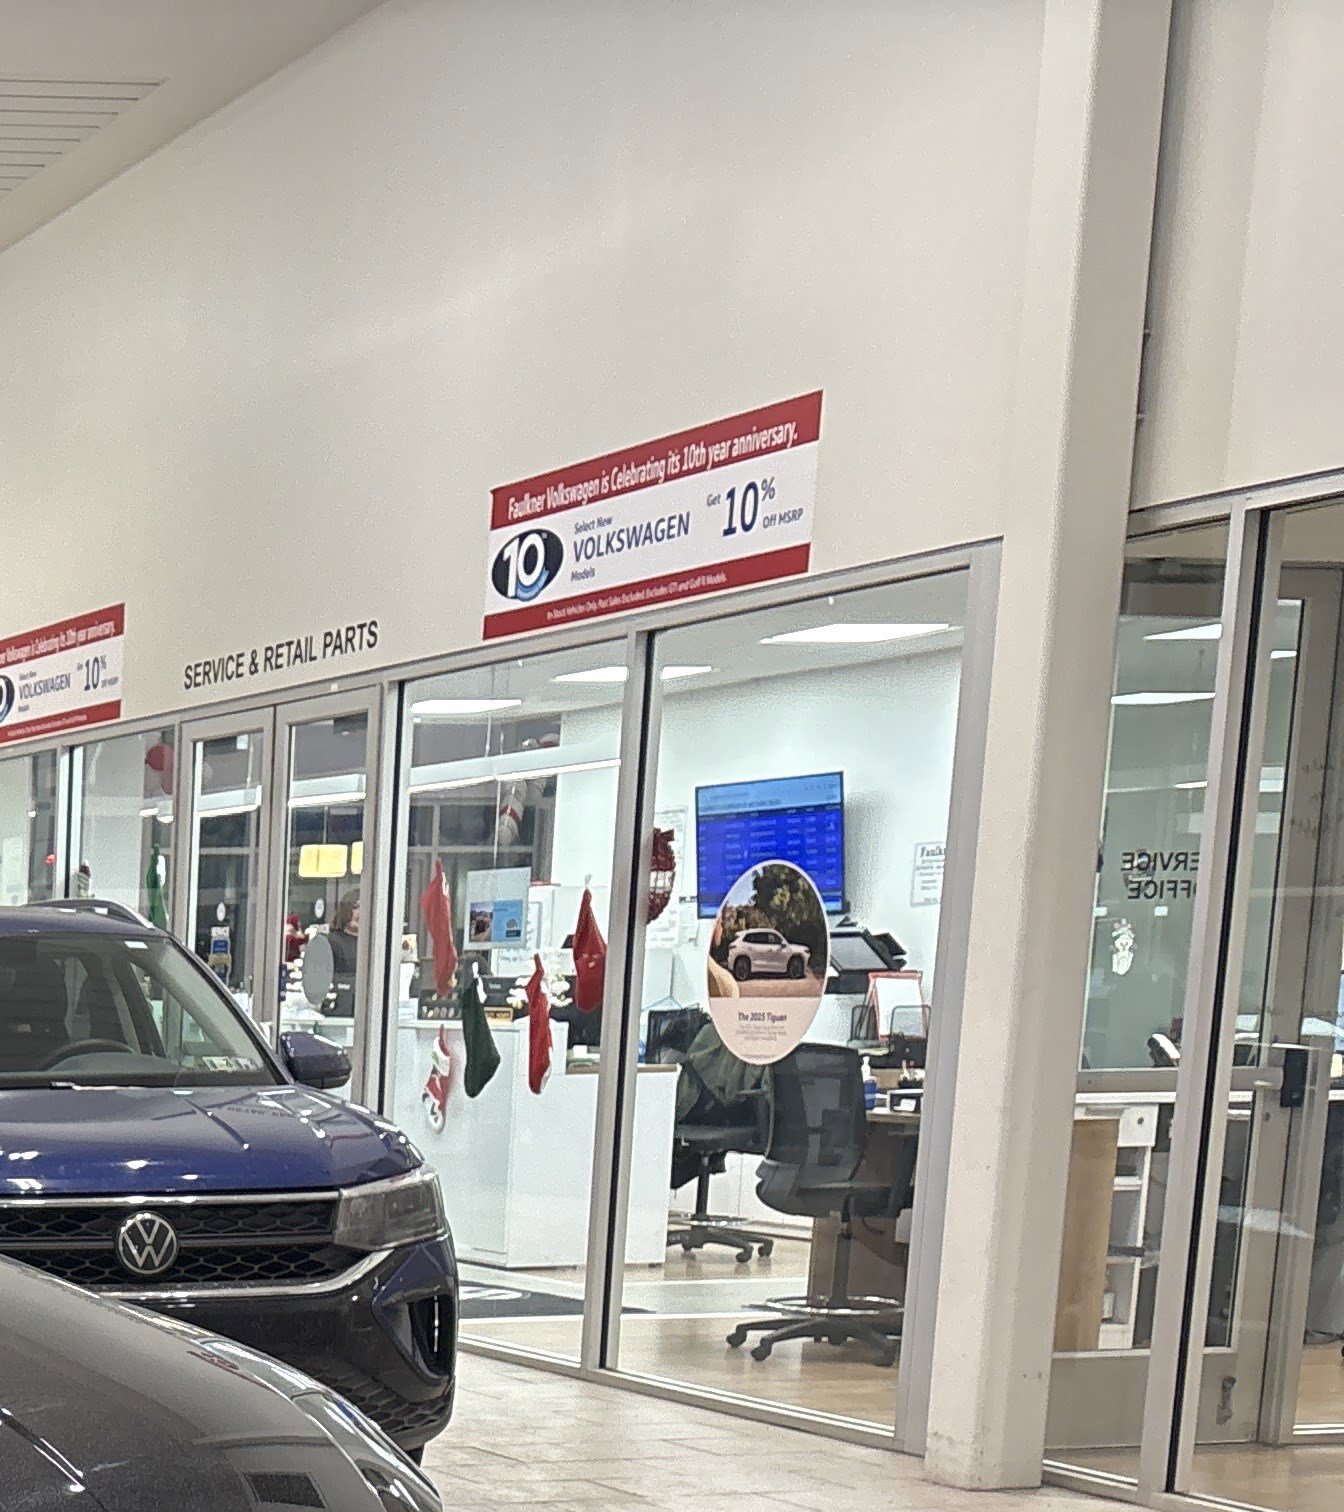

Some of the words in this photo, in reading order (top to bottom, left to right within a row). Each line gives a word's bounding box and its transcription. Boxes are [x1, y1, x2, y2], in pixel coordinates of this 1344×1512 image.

[508, 492, 545, 521] Faulkner
[546, 478, 600, 510] Volkswagen
[601, 469, 610, 494] is
[610, 454, 666, 492] Celebrating
[682, 441, 707, 471] 10th
[707, 439, 731, 470] year
[731, 421, 799, 457] anniversary.
[706, 493, 721, 507] Get
[574, 519, 596, 534] Select
[596, 516, 613, 528] New
[777, 507, 803, 525] MSRP
[574, 511, 690, 562] VOLKSWAGEN
[570, 566, 596, 582] Models
[184, 652, 245, 690] SERVICE
[248, 649, 259, 676] &
[264, 635, 317, 673] RETAIL
[322, 620, 378, 659] PARTS
[18, 673, 71, 700] VOLKSWAGEN
